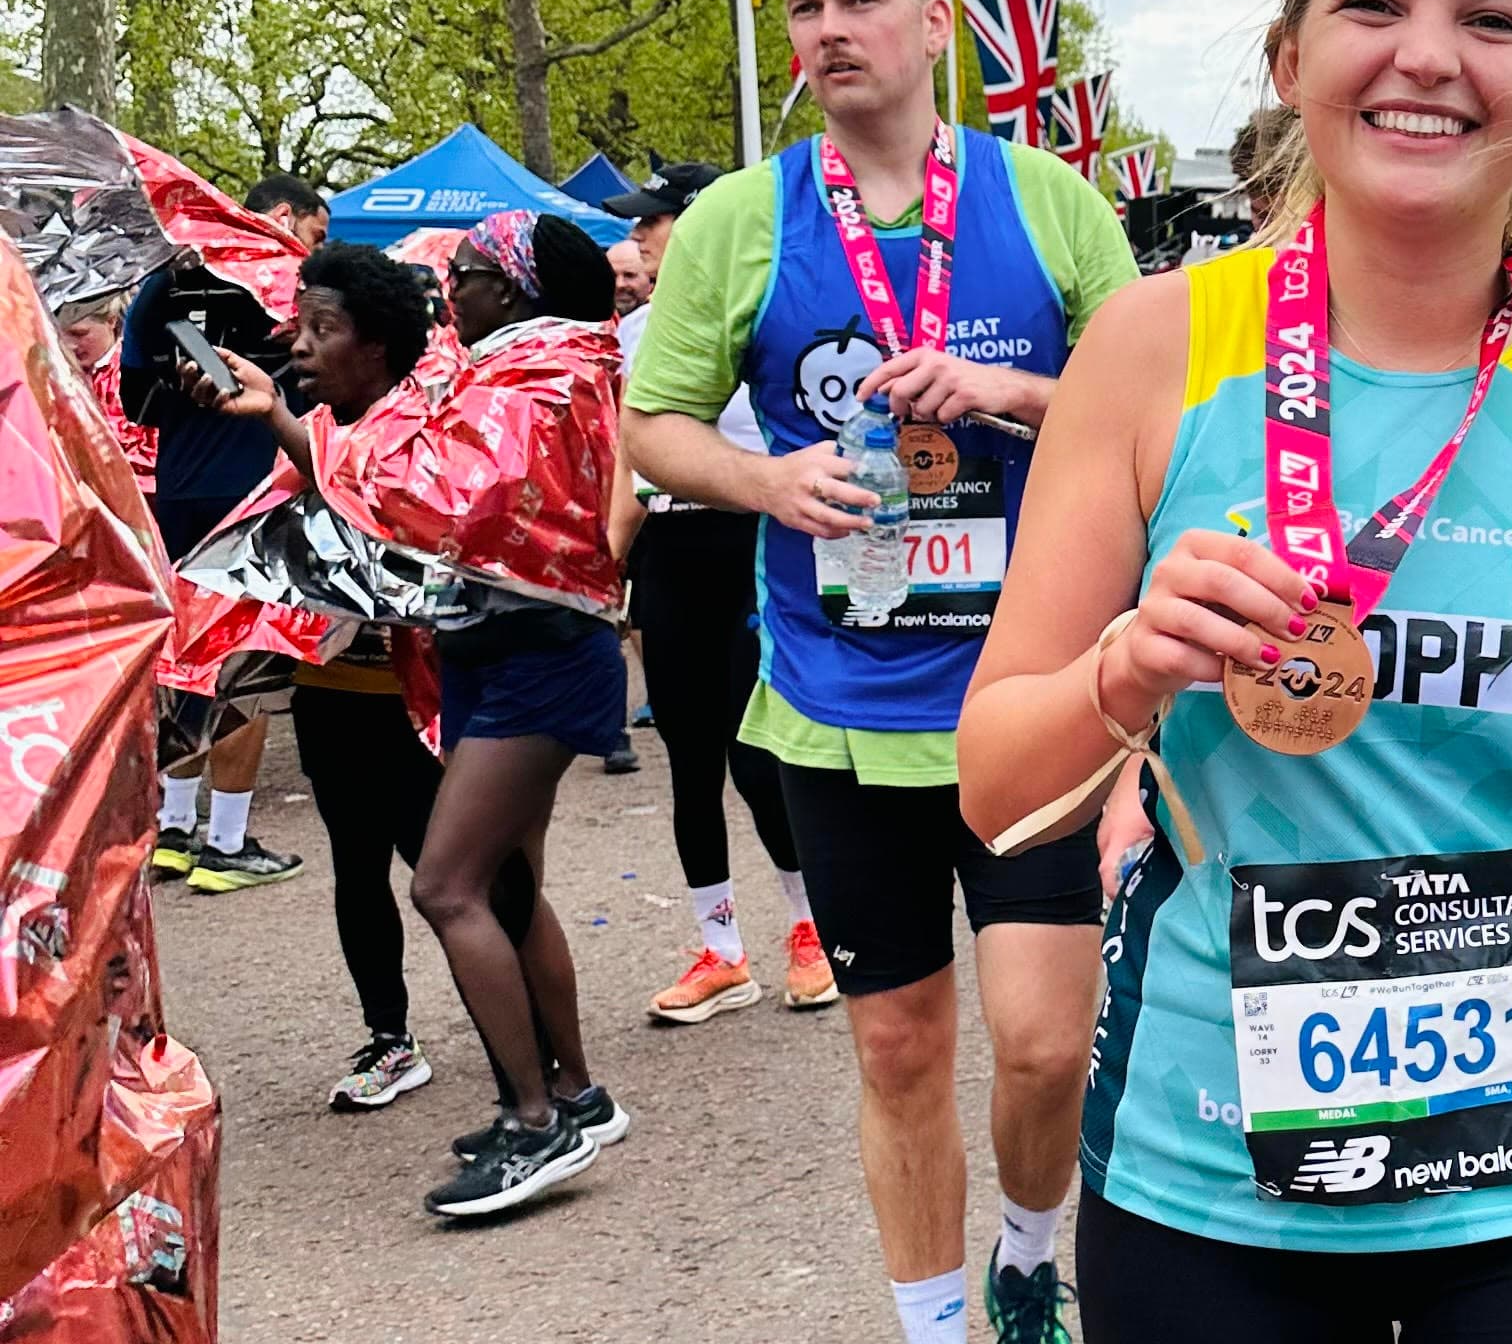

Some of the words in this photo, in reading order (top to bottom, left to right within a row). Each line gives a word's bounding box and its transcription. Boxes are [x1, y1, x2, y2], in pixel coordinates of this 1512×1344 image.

[831, 187, 867, 242] 2024
[945, 317, 1001, 340] REAT
[944, 338, 1033, 361] RMOND
[1278, 322, 1317, 422] 2024
[943, 481, 992, 494] LTANCY
[909, 496, 959, 510] RVICES
[904, 532, 973, 576] 701
[895, 616, 926, 627] new
[929, 612, 991, 627] balance
[1393, 872, 1470, 898] TATA
[1253, 884, 1381, 962] tcs
[1396, 923, 1511, 955] SERVICES
[1369, 979, 1455, 995] #WeRunTogether
[1249, 1023, 1275, 1033] WAVE
[1249, 1047, 1278, 1057] LORRY
[1318, 1108, 1357, 1121] MEDAL
[1394, 1159, 1453, 1190] new
